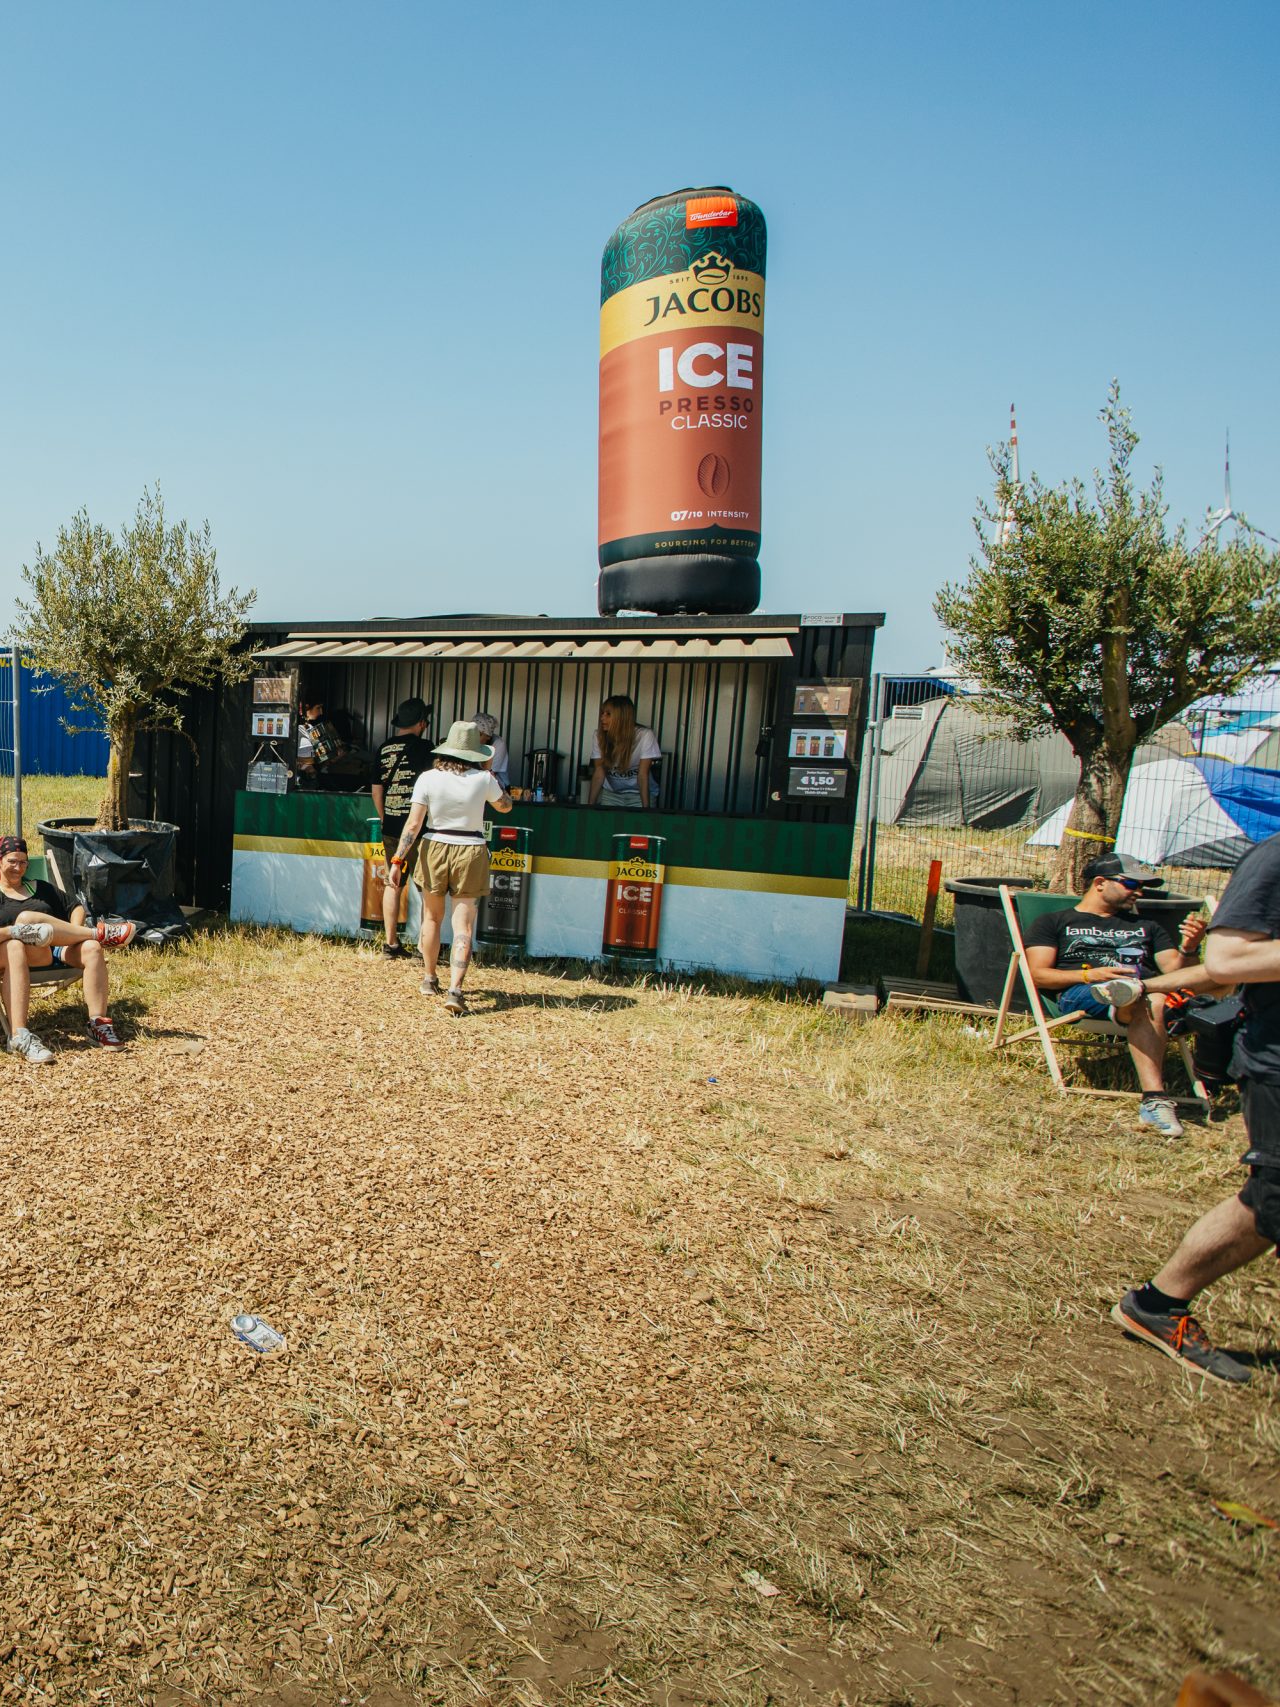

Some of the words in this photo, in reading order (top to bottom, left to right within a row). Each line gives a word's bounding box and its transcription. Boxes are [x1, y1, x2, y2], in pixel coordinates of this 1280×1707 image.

[643, 287, 761, 326] JACOBS
[658, 342, 754, 392] ICE
[659, 395, 754, 415] PRESSO
[671, 413, 748, 430] CLASSIC
[671, 510, 703, 521] 07/10
[707, 510, 750, 519] INTENSITY
[654, 538, 706, 549] SOURCING
[370, 848, 386, 857] JAC
[490, 857, 526, 868] ACOBS
[371, 864, 385, 879] IC
[616, 866, 658, 878] JACOBS
[490, 874, 521, 891] ICE
[616, 884, 653, 903] ICE
